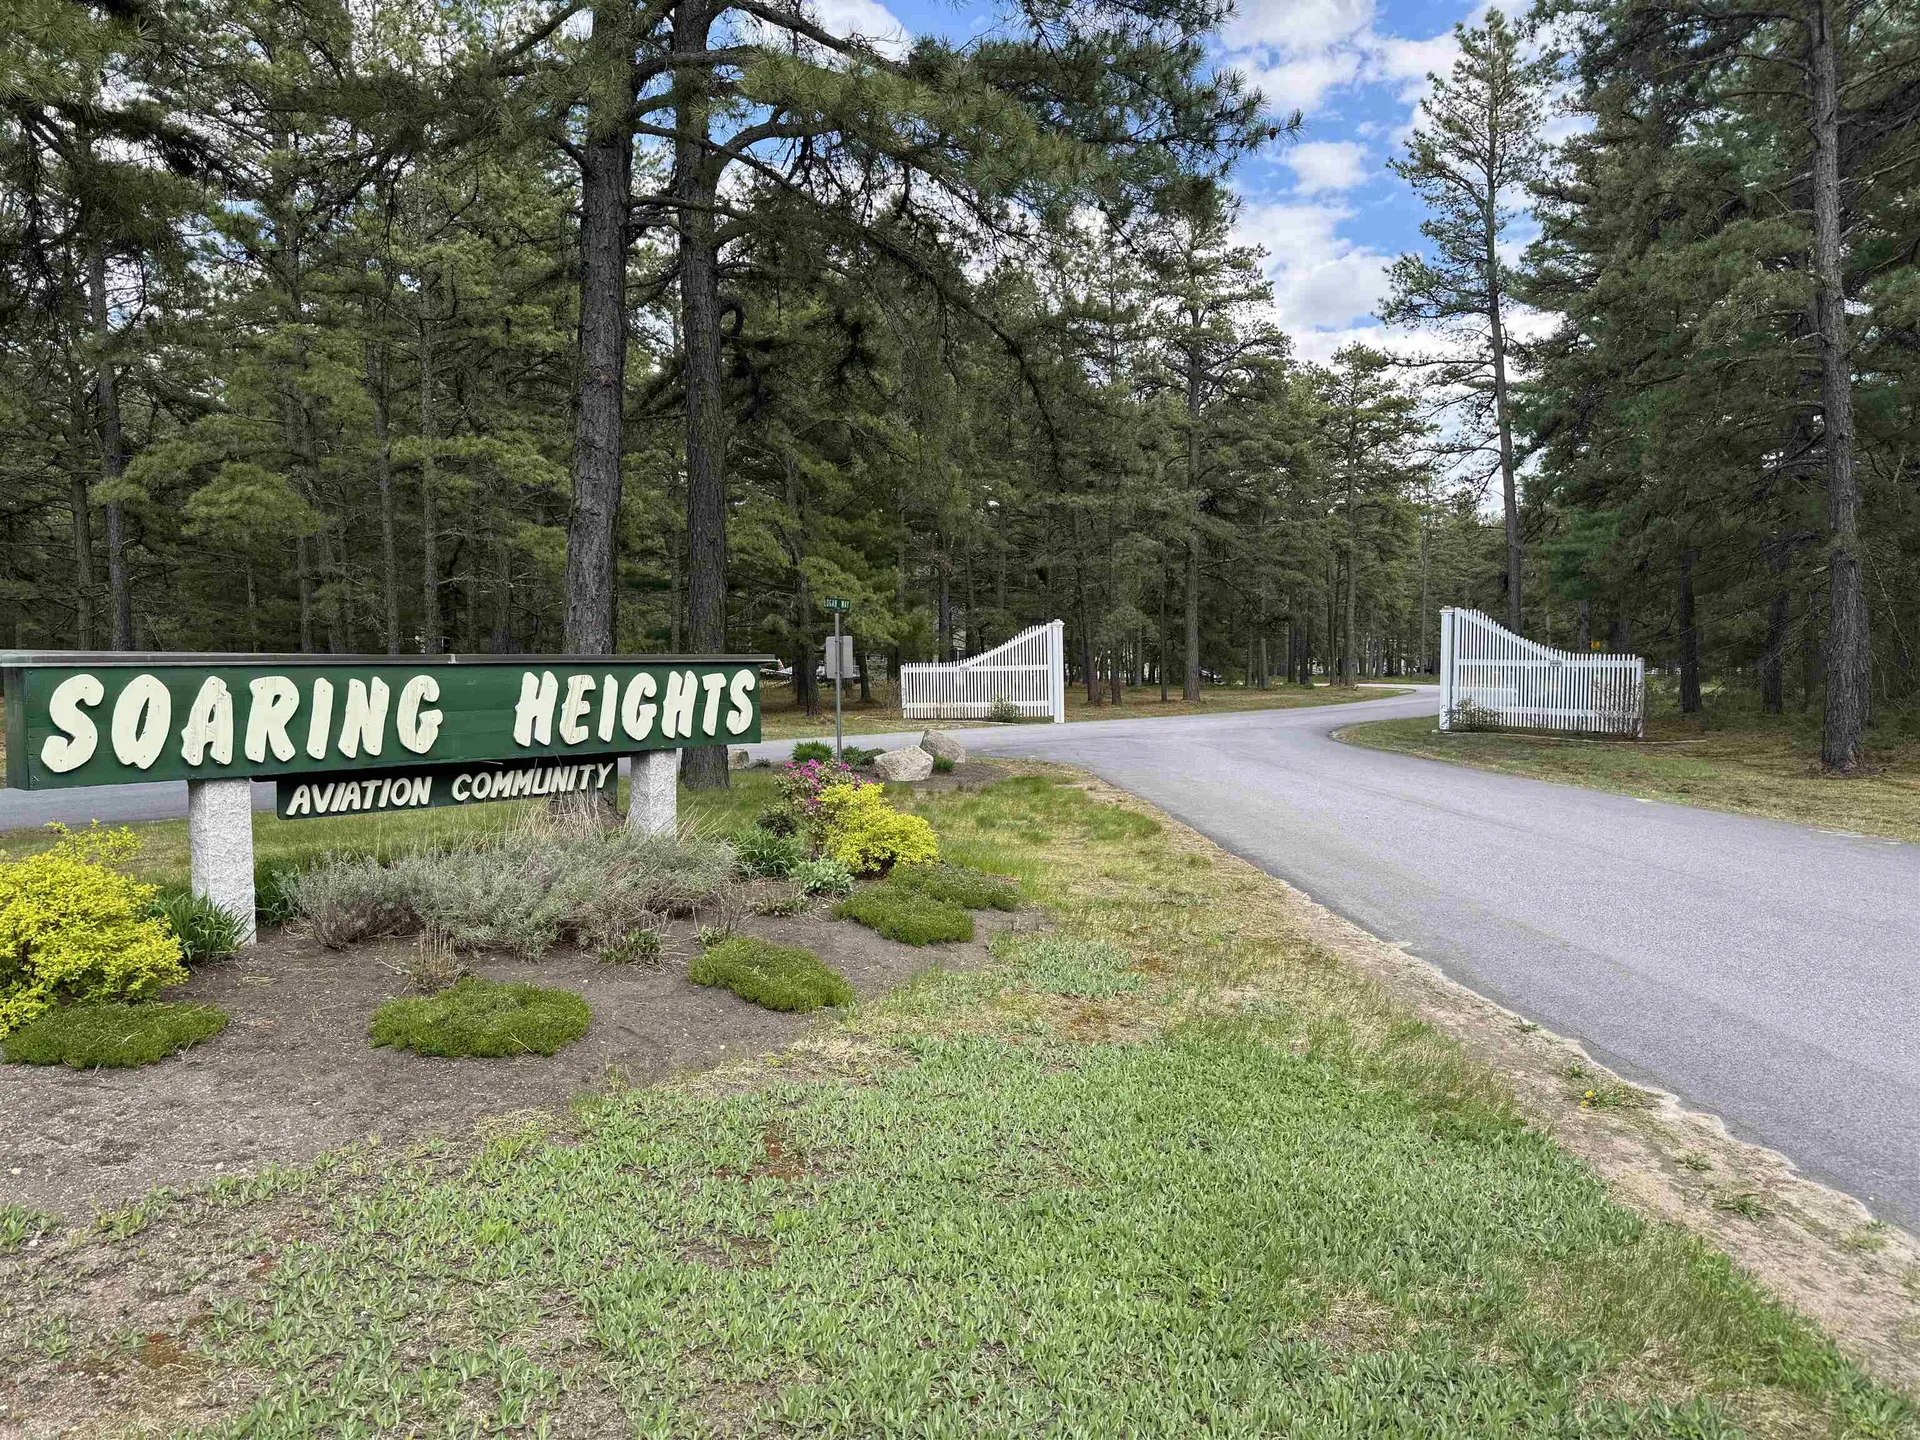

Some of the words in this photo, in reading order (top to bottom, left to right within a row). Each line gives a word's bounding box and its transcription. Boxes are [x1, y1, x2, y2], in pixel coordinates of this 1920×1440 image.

[841, 600, 850, 608] WAY
[41, 673, 443, 773] SOARING
[513, 669, 756, 747] HEIGHTS
[286, 777, 432, 816] AVIATION
[451, 763, 614, 802] COMMUNITY
